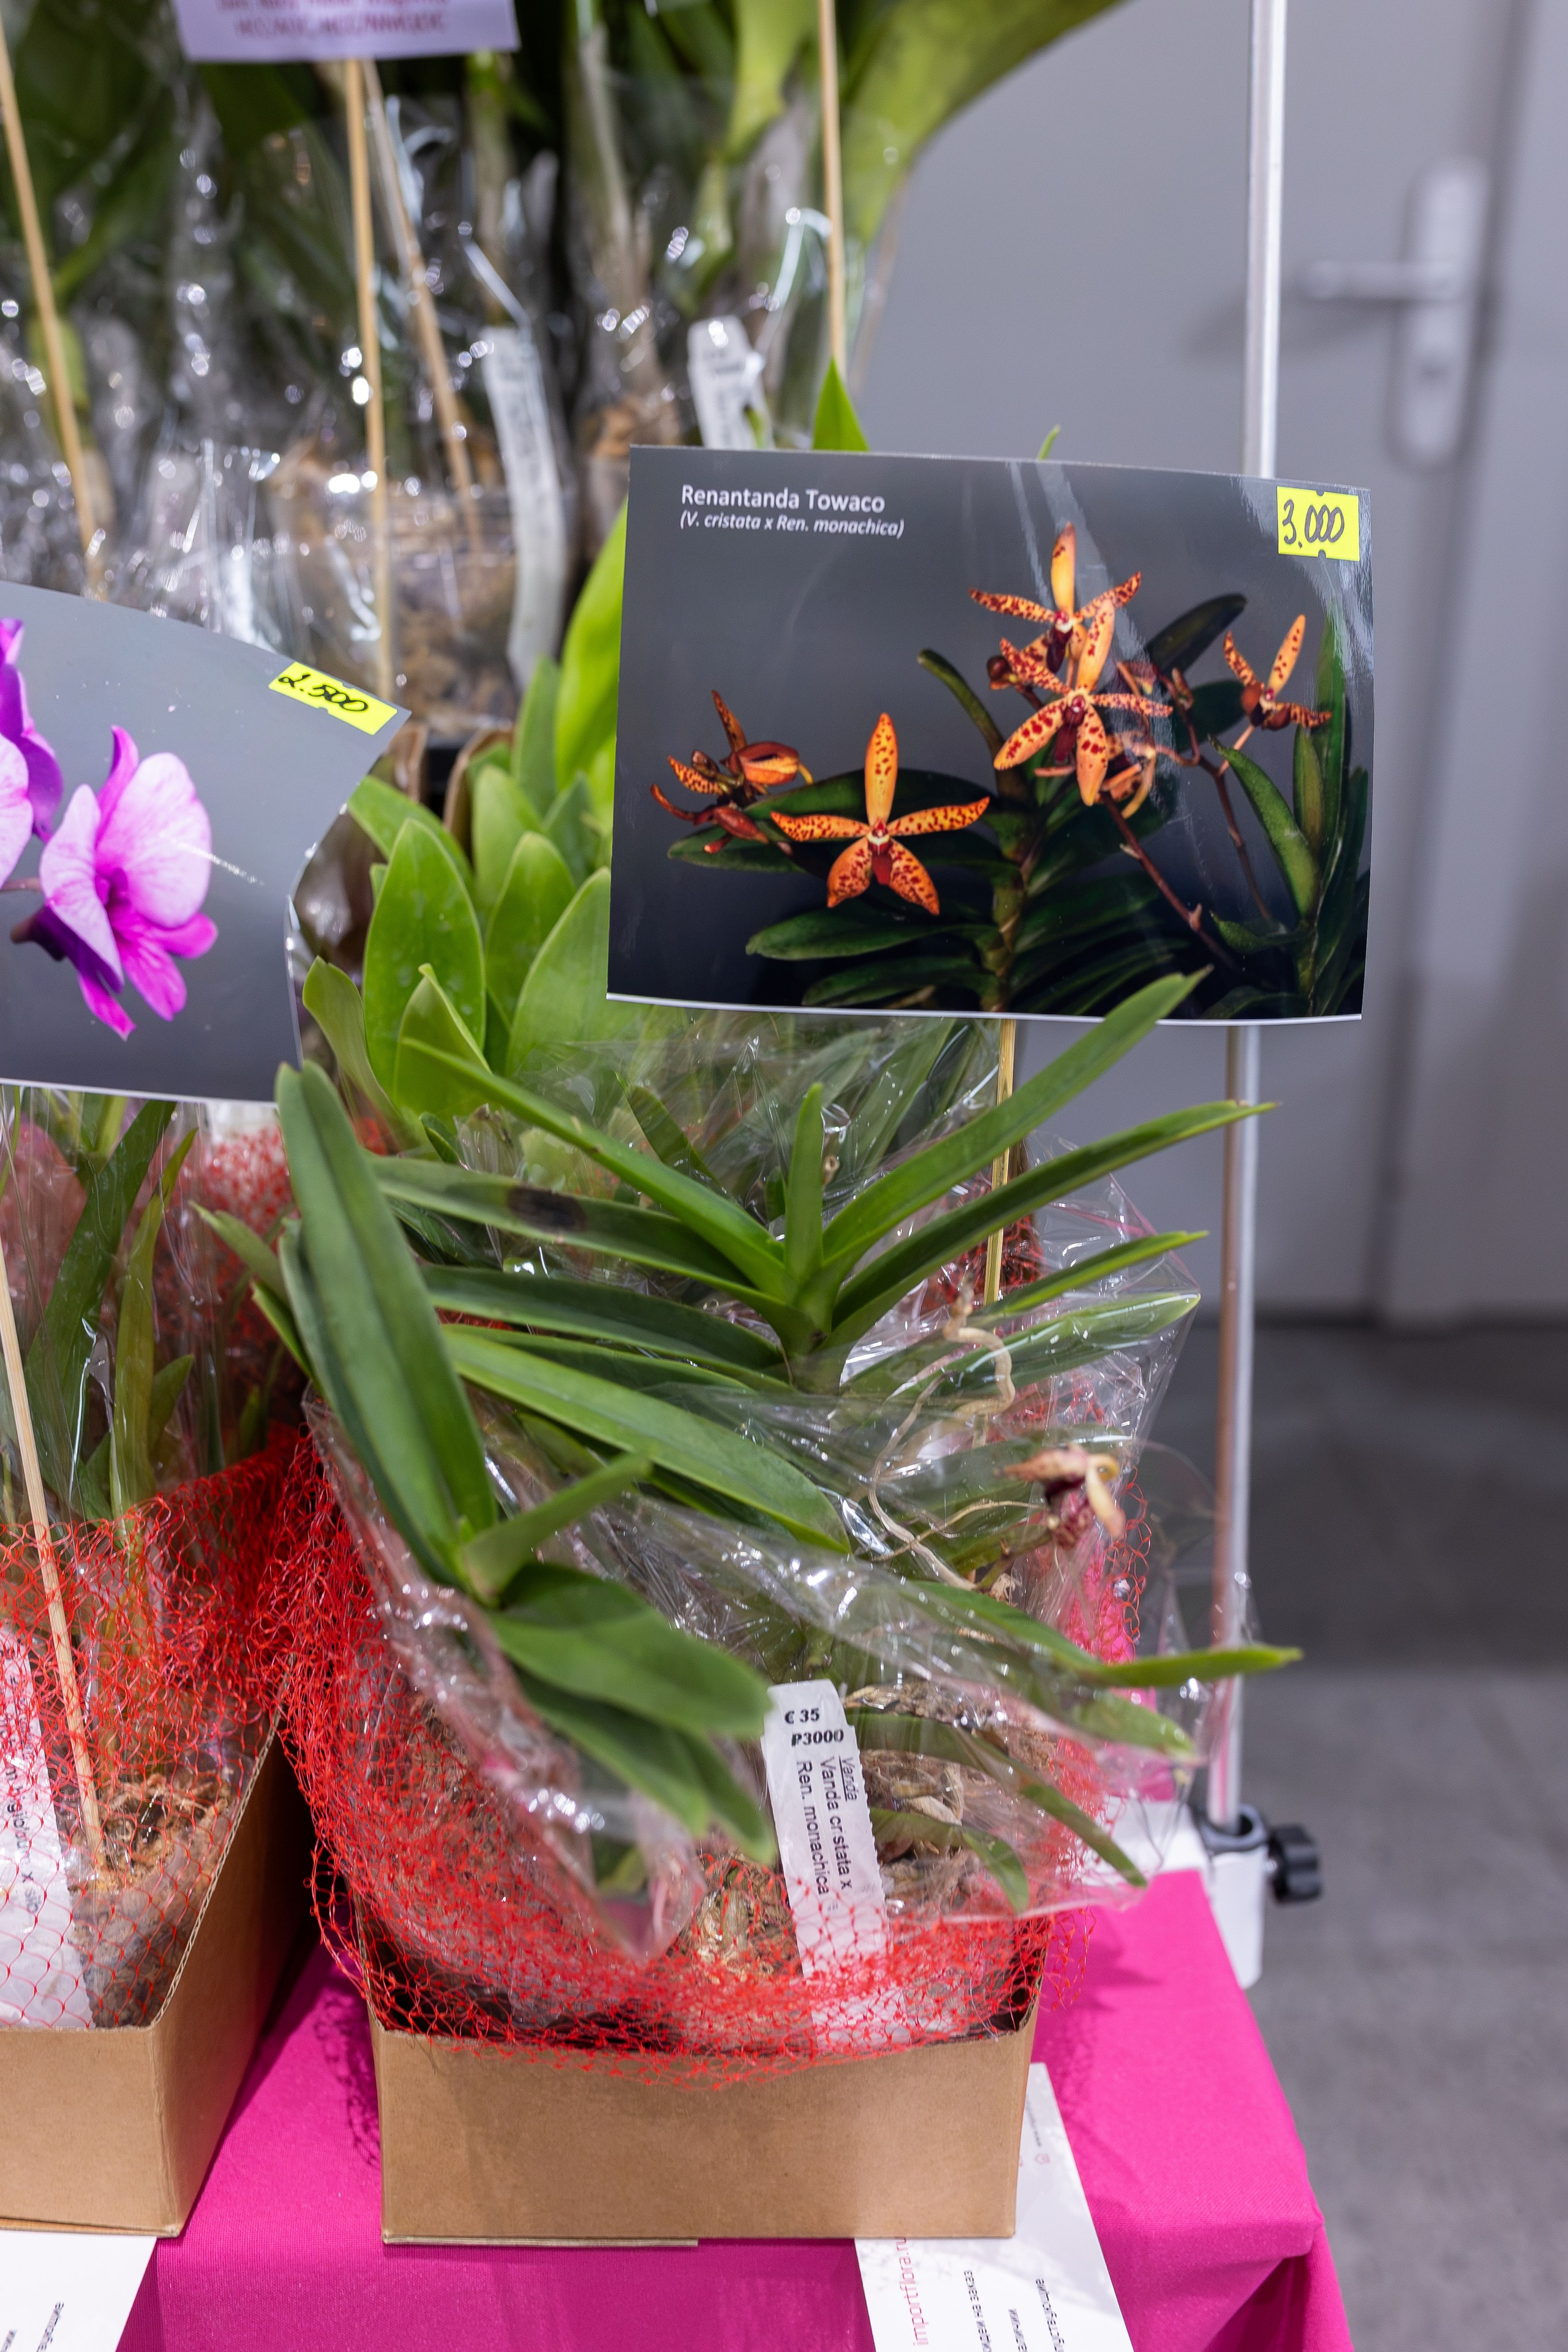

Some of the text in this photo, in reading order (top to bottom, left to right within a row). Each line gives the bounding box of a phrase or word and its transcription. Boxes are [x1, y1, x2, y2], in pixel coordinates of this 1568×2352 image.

[681, 484, 886, 513] Renantanda Towaco
[680, 509, 905, 540] (V. cristata x Ren. monachica)
[799, 1707, 820, 1723] 35
[797, 1760, 830, 1896] Ren. monachica
[820, 1755, 842, 1811] Vanda
[840, 1879, 853, 1890] x
